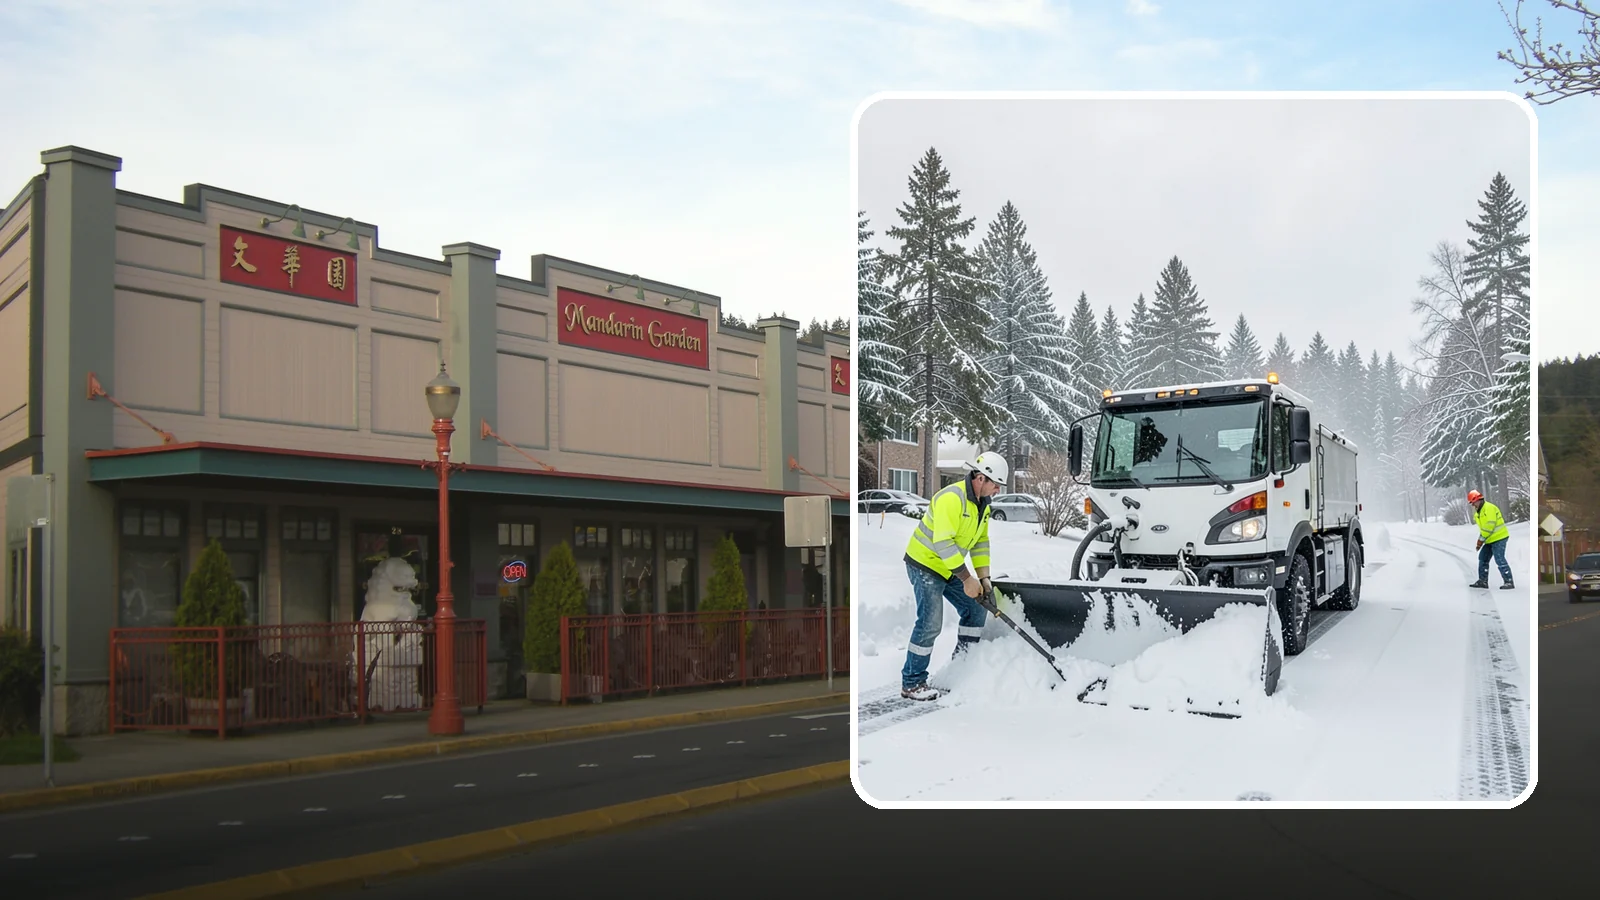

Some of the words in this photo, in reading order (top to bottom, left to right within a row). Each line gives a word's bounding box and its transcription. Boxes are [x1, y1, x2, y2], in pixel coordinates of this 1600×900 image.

[231, 235, 346, 291] 文華園
[564, 302, 644, 341] Mandarin
[648, 320, 702, 352] Garden
[503, 565, 527, 579] OPEN
